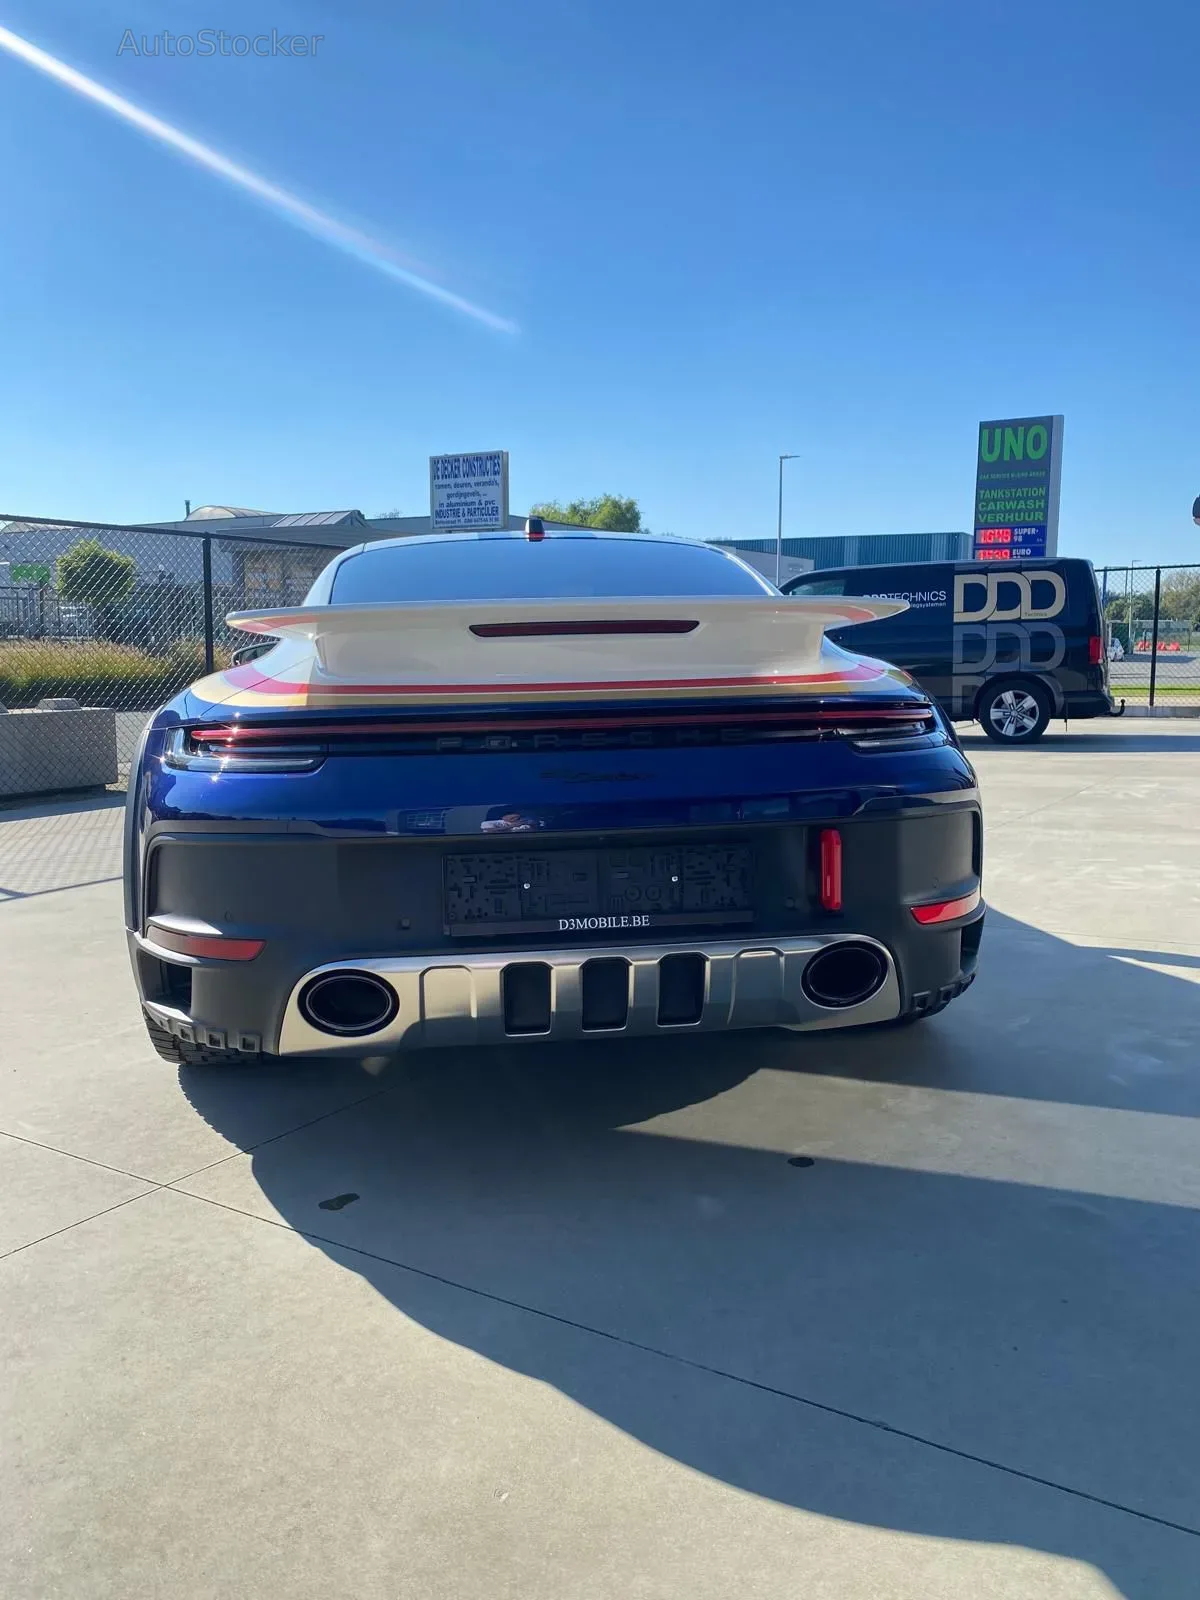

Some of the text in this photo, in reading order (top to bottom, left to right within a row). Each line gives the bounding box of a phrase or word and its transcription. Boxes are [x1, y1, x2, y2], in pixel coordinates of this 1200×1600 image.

[981, 424, 1048, 463] UNO
[441, 458, 461, 479] DECKER
[462, 455, 500, 478] CONSTRUCTIES
[979, 487, 1046, 500] TANKSTATION
[435, 508, 460, 518] INDUSTRIE
[467, 506, 499, 517] PARTICULIER
[446, 500, 476, 508] aluminium
[484, 500, 496, 508] pvc
[978, 499, 1045, 511] CARWASH
[978, 511, 1044, 523] VERHUUR
[953, 570, 1066, 623] DDD
[952, 621, 1066, 674] DDD
[436, 727, 748, 752] PORSCHE
[558, 915, 651, 932] D3MOBILE.BE
